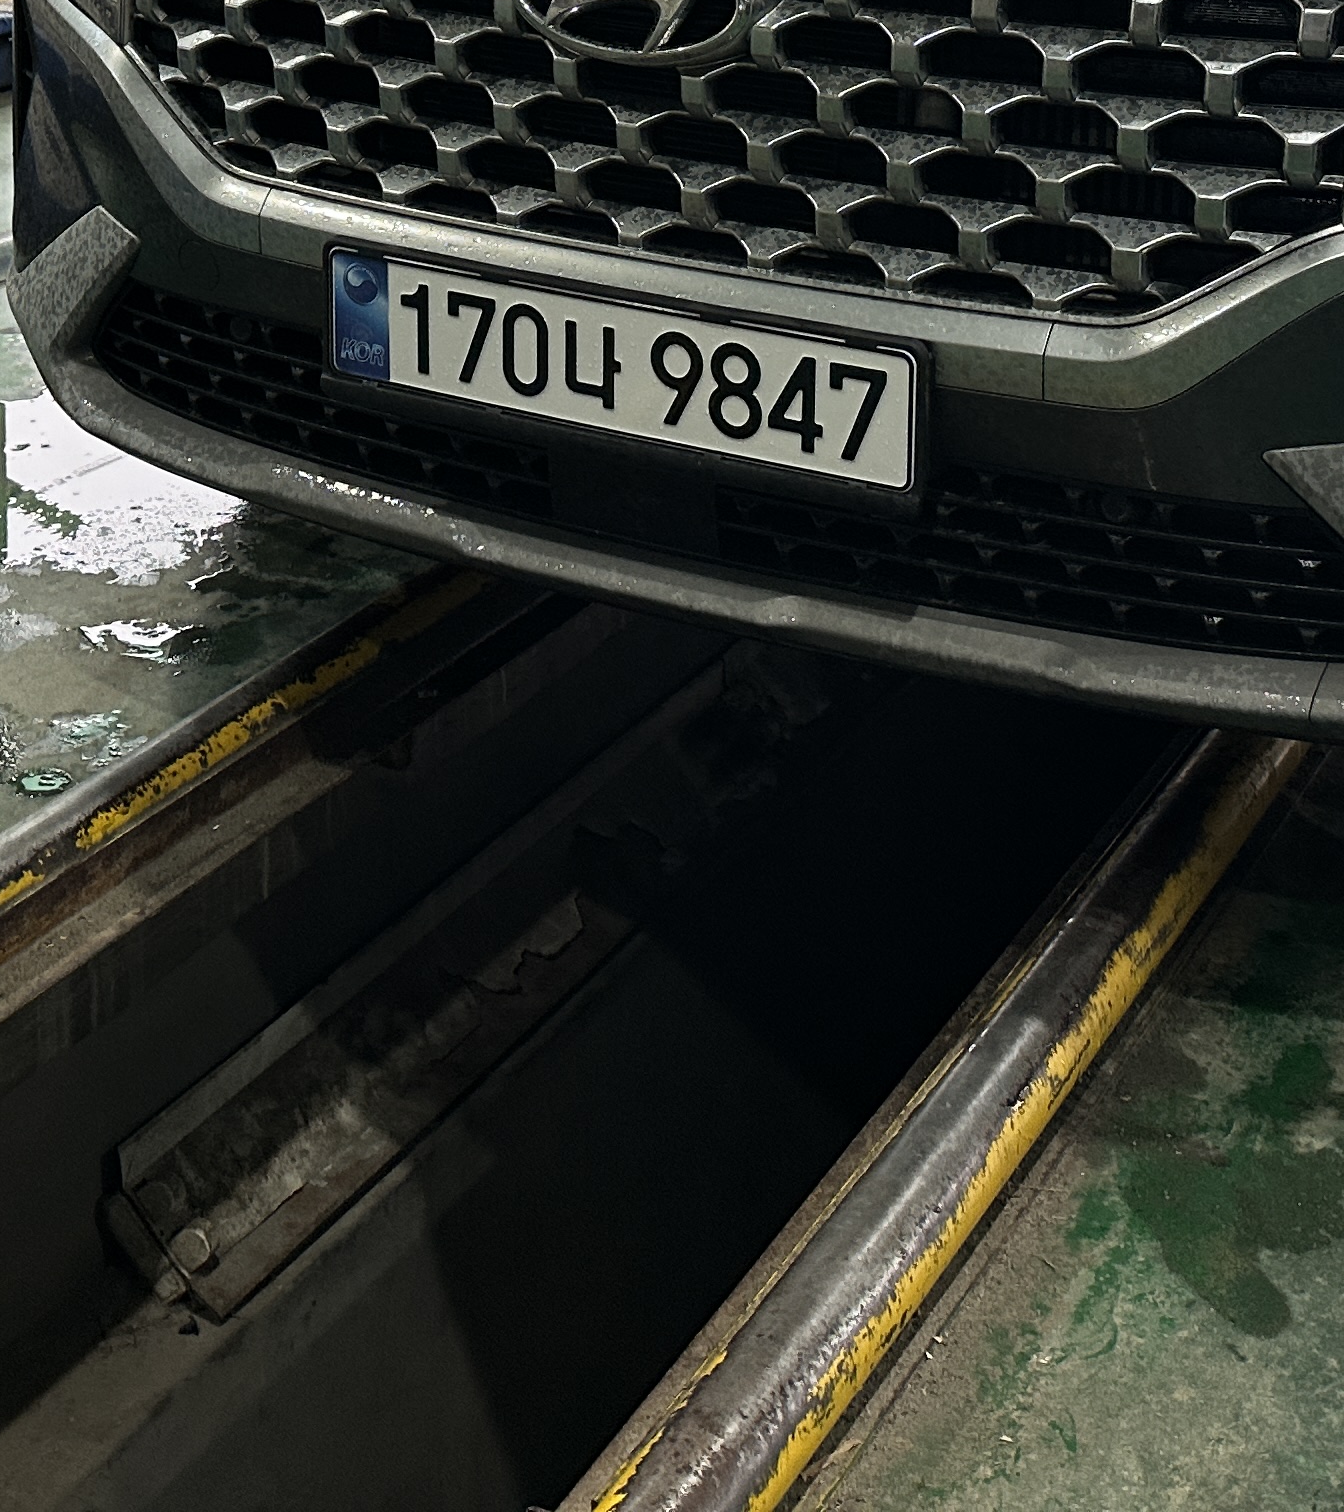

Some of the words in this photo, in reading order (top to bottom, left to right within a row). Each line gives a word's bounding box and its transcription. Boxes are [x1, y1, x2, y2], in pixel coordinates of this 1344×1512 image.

[340, 337, 385, 367] KOR
[400, 283, 622, 410] 170나
[650, 330, 888, 461] 9847
